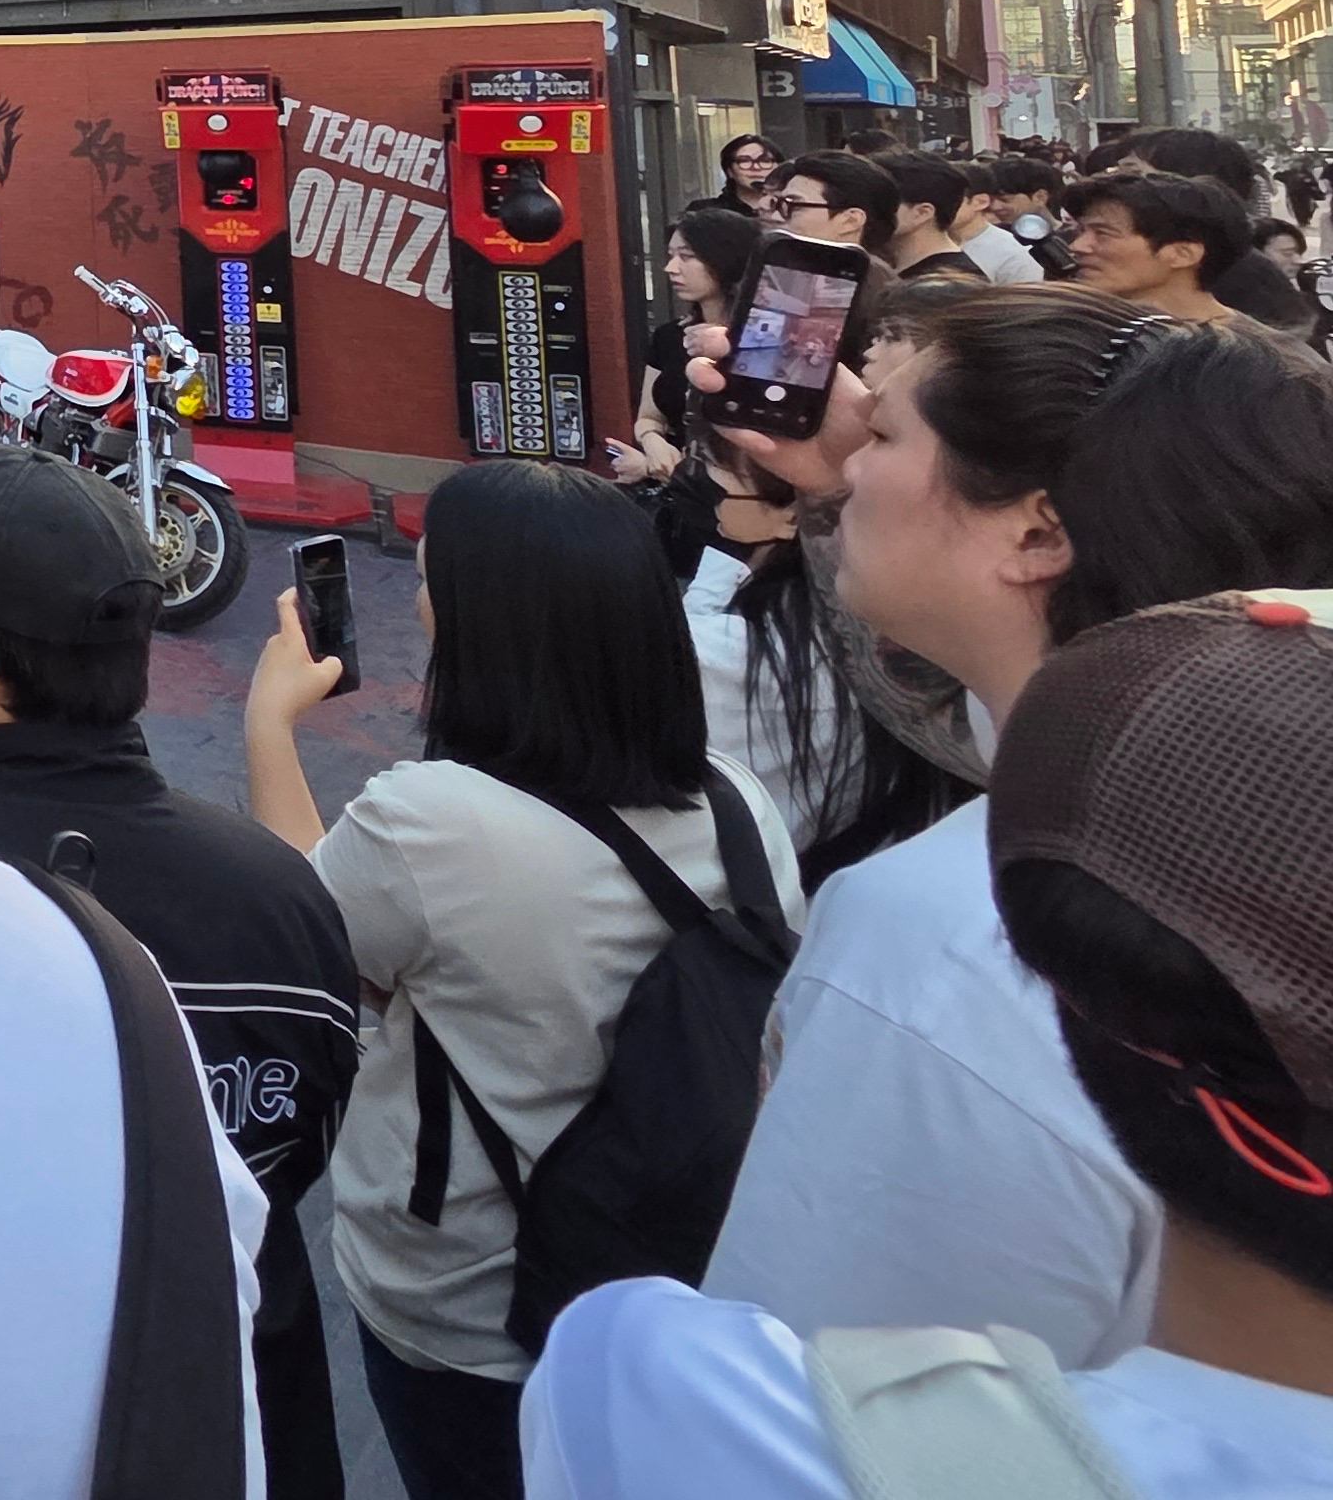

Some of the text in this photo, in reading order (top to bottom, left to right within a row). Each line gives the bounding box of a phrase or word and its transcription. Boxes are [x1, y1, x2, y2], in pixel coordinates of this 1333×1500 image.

[167, 84, 267, 101] DRAGON PUNCH
[470, 79, 590, 97] DRAGON PUNCH
[288, 167, 454, 310] ONIZU
